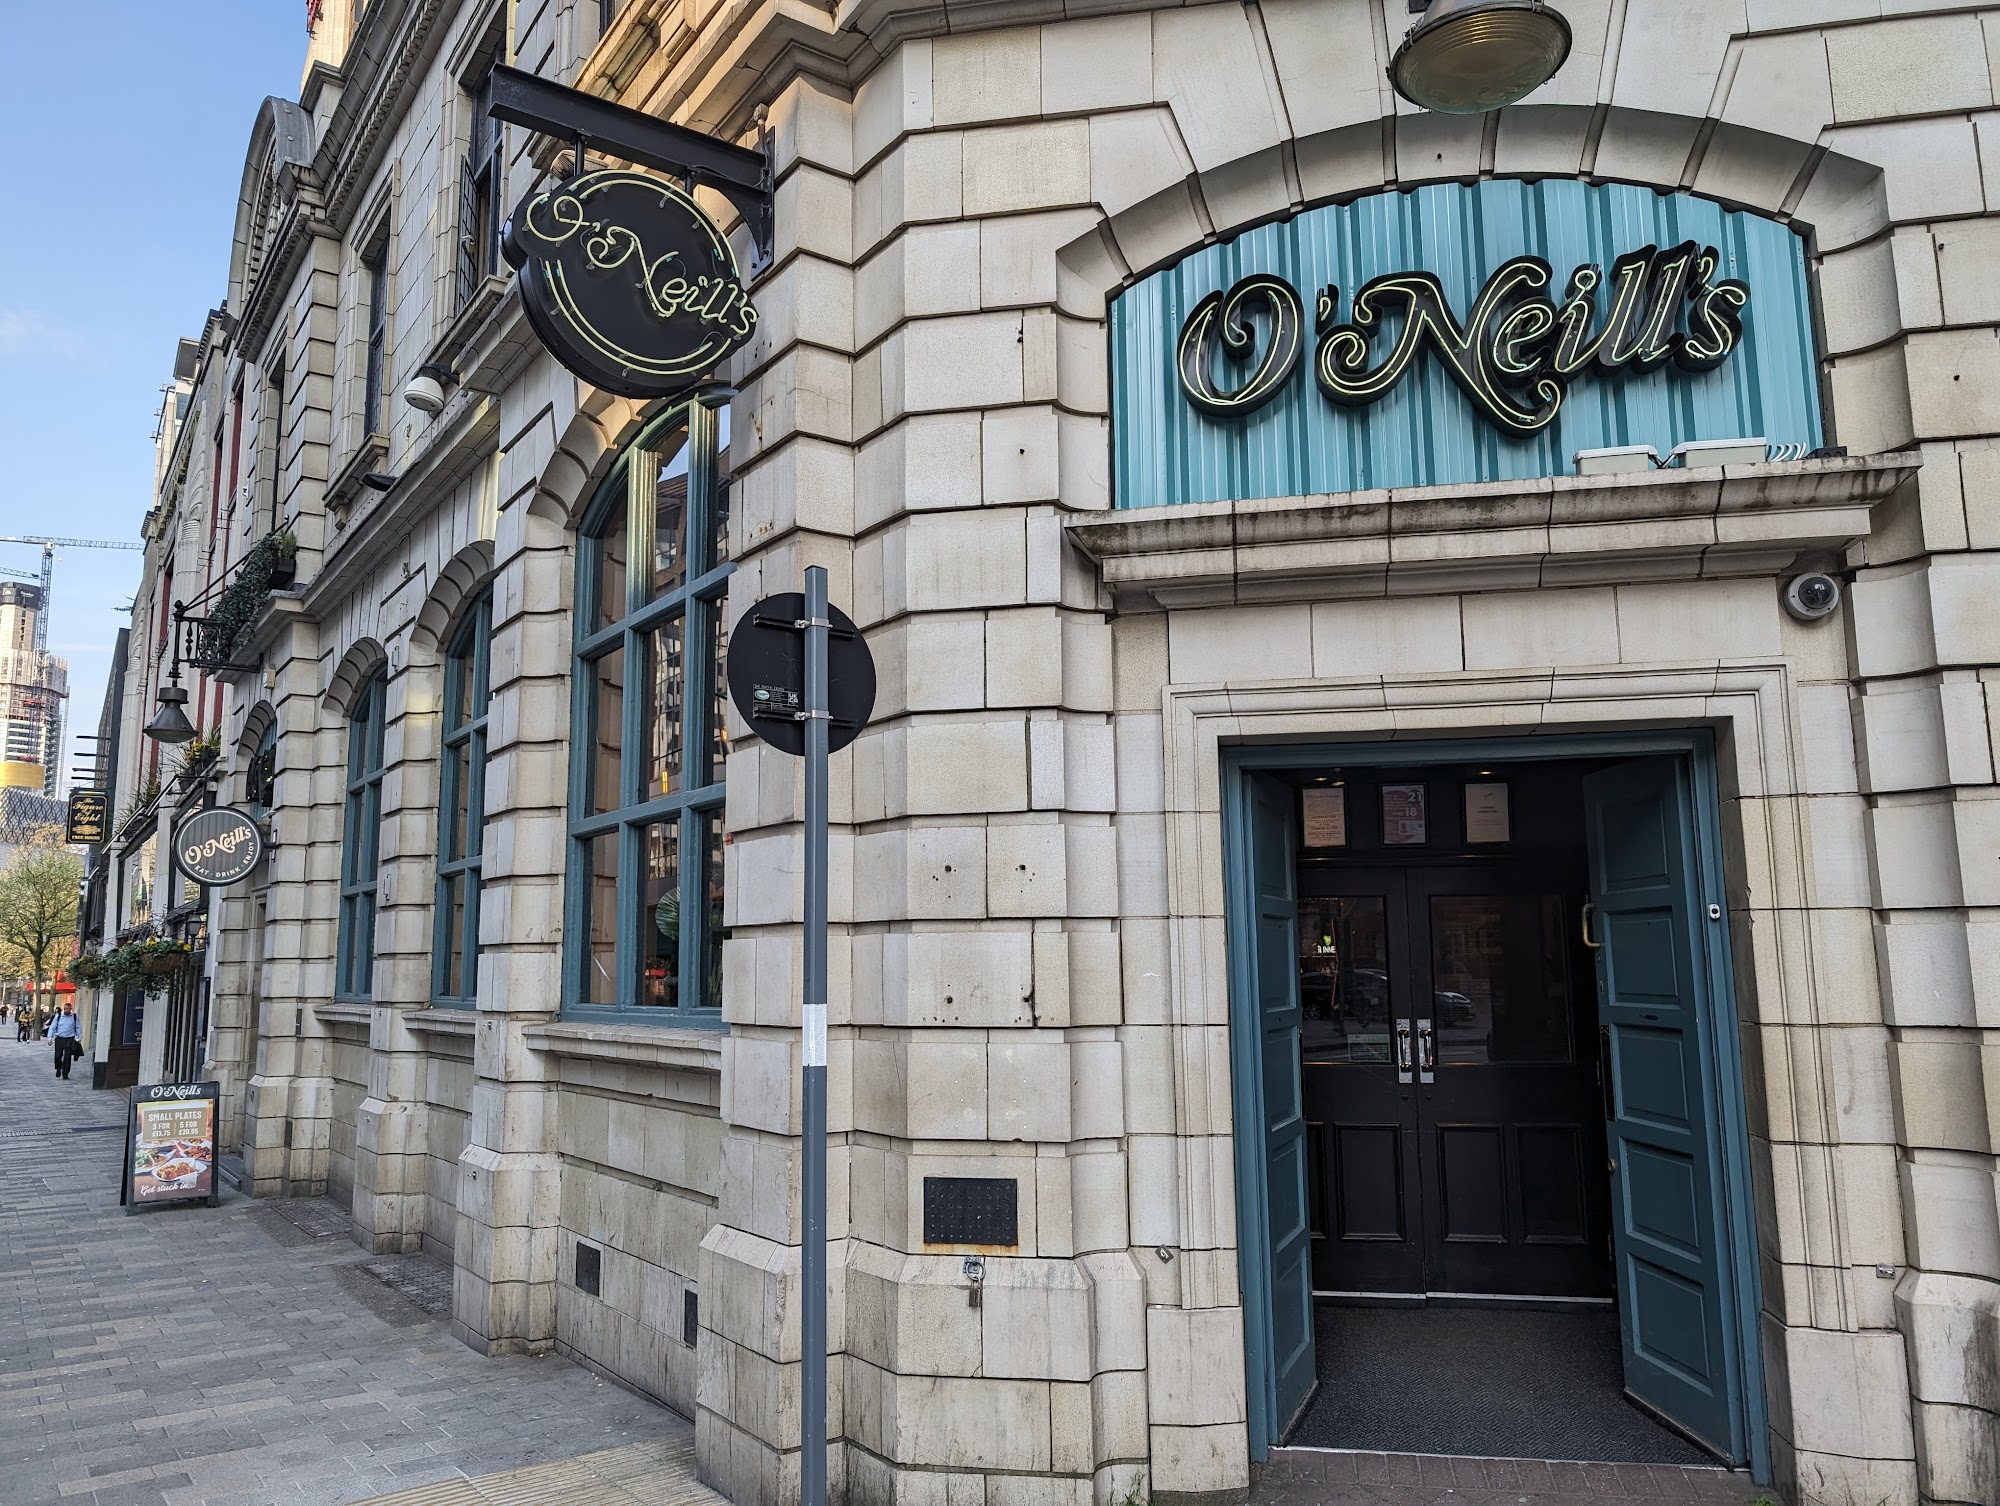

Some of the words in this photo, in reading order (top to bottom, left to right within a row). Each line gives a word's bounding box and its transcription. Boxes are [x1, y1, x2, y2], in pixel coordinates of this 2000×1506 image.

[526, 192, 758, 335] O'Neill's
[1177, 239, 1751, 439] O'Neill's
[72, 801, 104, 813] Figure
[1404, 807, 1418, 817] 18
[74, 812, 101, 824] Eight
[184, 826, 252, 865] O'Neill's
[194, 865, 210, 876] EAT
[215, 866, 241, 878] DRINK
[242, 841, 255, 865] ENJOY
[148, 1112, 173, 1122] SMALL
[175, 1111, 202, 1120] PLATES
[158, 1122, 171, 1130] FOR
[140, 1184, 156, 1196] Get
[156, 1182, 179, 1192] stuck
